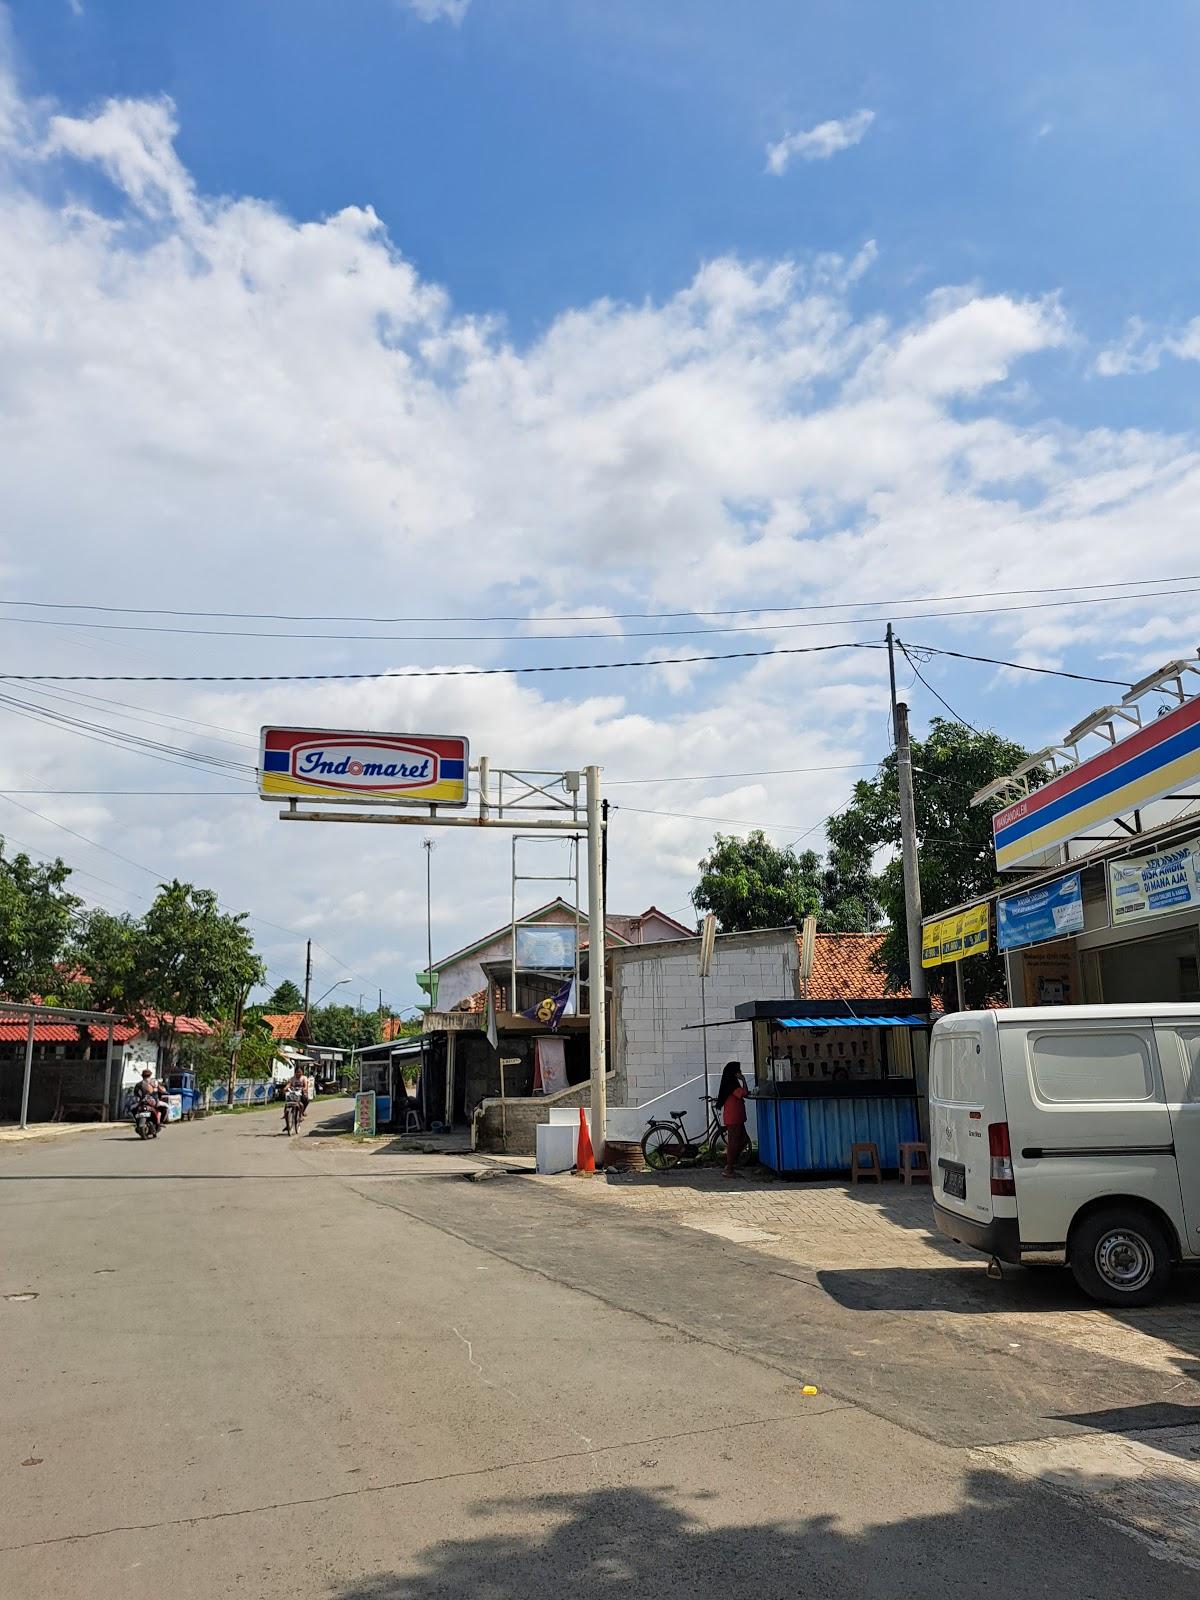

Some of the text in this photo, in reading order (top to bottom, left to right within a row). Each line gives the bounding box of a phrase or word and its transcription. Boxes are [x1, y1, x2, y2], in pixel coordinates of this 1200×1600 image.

[299, 751, 429, 778] Indomaret
[1142, 869, 1160, 882] BISA
[1143, 883, 1151, 893] DI
[1150, 876, 1171, 891] MANA
[1171, 871, 1188, 886] AJA!
